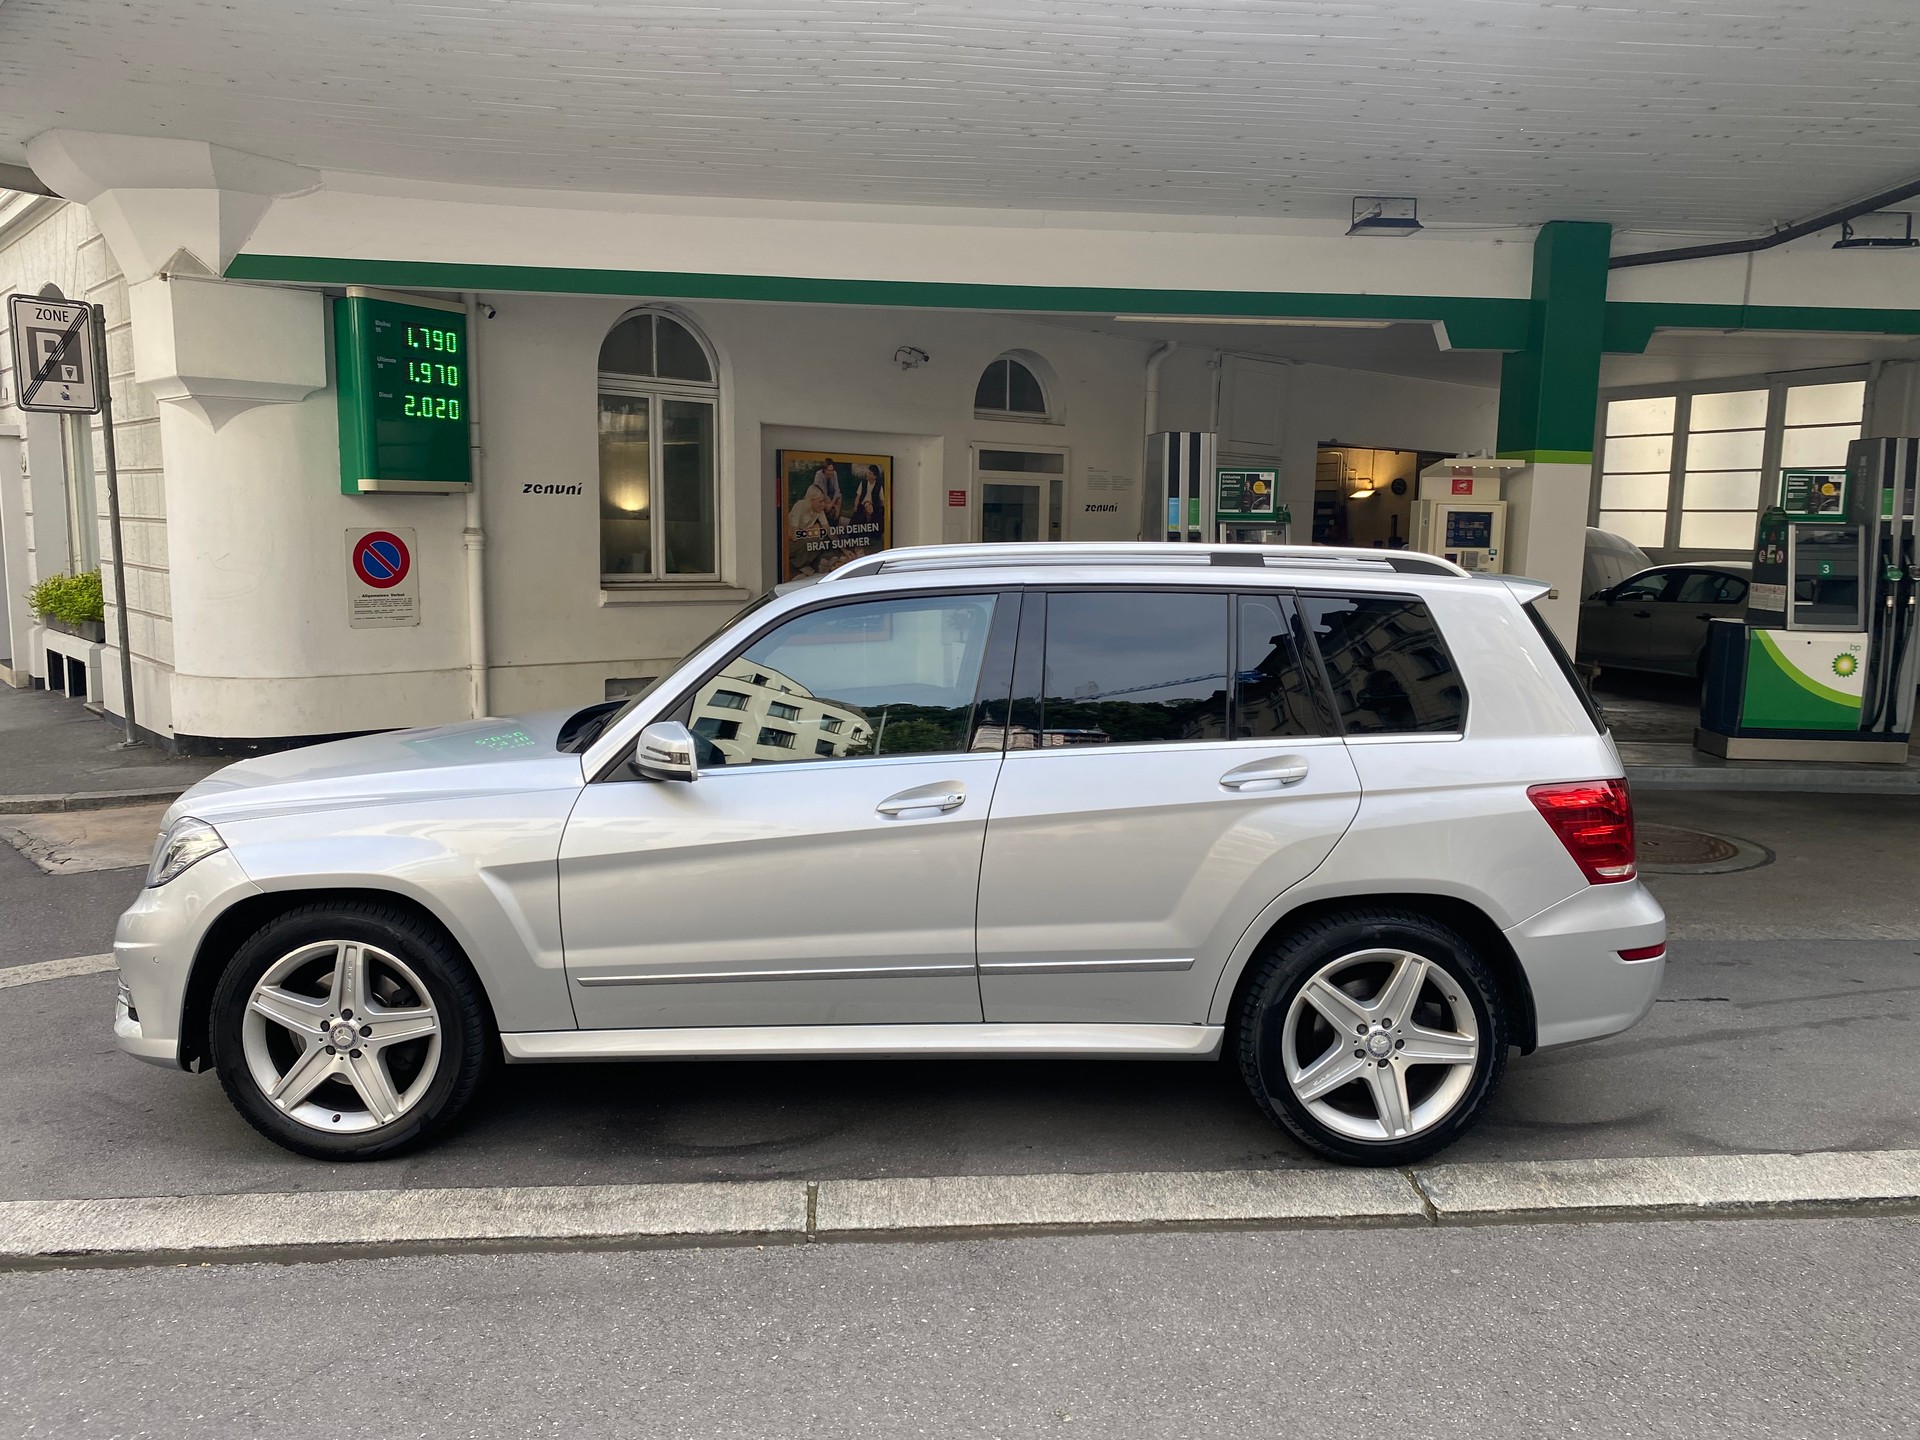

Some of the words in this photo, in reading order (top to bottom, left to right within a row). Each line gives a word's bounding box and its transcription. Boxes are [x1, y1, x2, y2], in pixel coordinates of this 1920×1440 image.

[35, 308, 69, 323] ZONE
[407, 327, 457, 352] 1.790
[409, 362, 458, 386] 1.970
[404, 395, 459, 419] 2.020
[522, 482, 583, 495] zenuni
[1085, 502, 1118, 512] zenuni
[830, 525, 845, 536] DIR
[846, 522, 879, 534] DEINEN
[806, 540, 830, 552] BRAT
[832, 536, 870, 549] SUMMER
[1822, 564, 1830, 574] 3
[1850, 644, 1861, 652] bp
